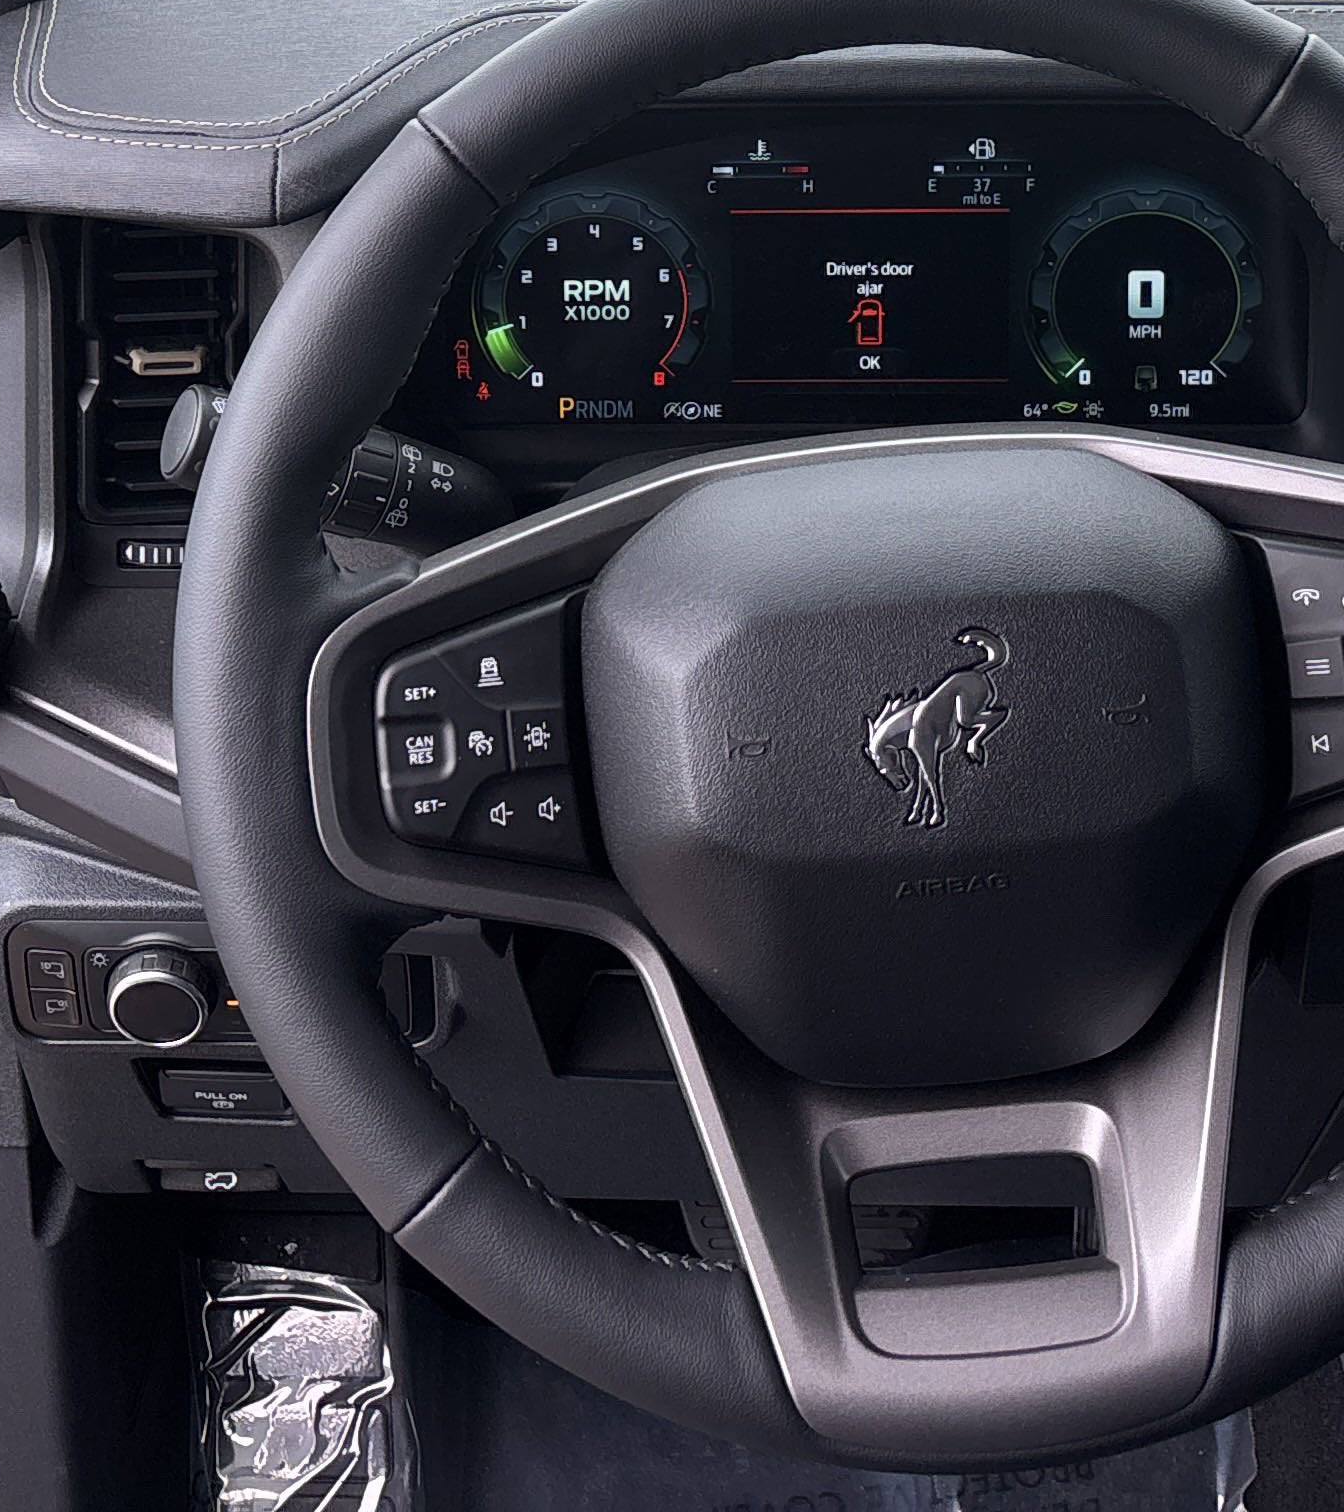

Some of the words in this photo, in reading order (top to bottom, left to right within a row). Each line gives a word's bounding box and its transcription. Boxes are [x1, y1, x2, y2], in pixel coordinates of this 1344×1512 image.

[707, 180, 718, 194] C
[802, 180, 814, 193] H
[928, 178, 937, 192] E
[973, 178, 991, 192] 37
[1026, 178, 1035, 192] F
[979, 193, 991, 205] to
[589, 224, 600, 238] 4
[547, 238, 558, 252] 3
[633, 238, 644, 251] 5
[659, 269, 670, 283] 6
[826, 262, 878, 276] Driver's
[881, 262, 914, 276] door
[521, 270, 533, 284] 2
[563, 279, 631, 302] RPM
[856, 281, 884, 296] ajar
[1128, 269, 1165, 318] 0
[564, 305, 631, 321] X1000
[519, 316, 526, 330] 1
[664, 315, 674, 329] 7
[1129, 325, 1162, 339] MPH
[859, 355, 881, 370] OK
[532, 372, 543, 387] 0
[654, 372, 665, 386] 8
[1079, 371, 1091, 385] 0
[1179, 369, 1213, 385] 120
[703, 404, 723, 418] NE
[408, 463, 416, 474] 2
[404, 687, 437, 702] SET+
[406, 735, 434, 749] CAN
[409, 752, 434, 766] RES
[896, 874, 1010, 899] AIRBAG
[195, 1092, 227, 1101] PULL
[229, 1092, 248, 1101] ON
